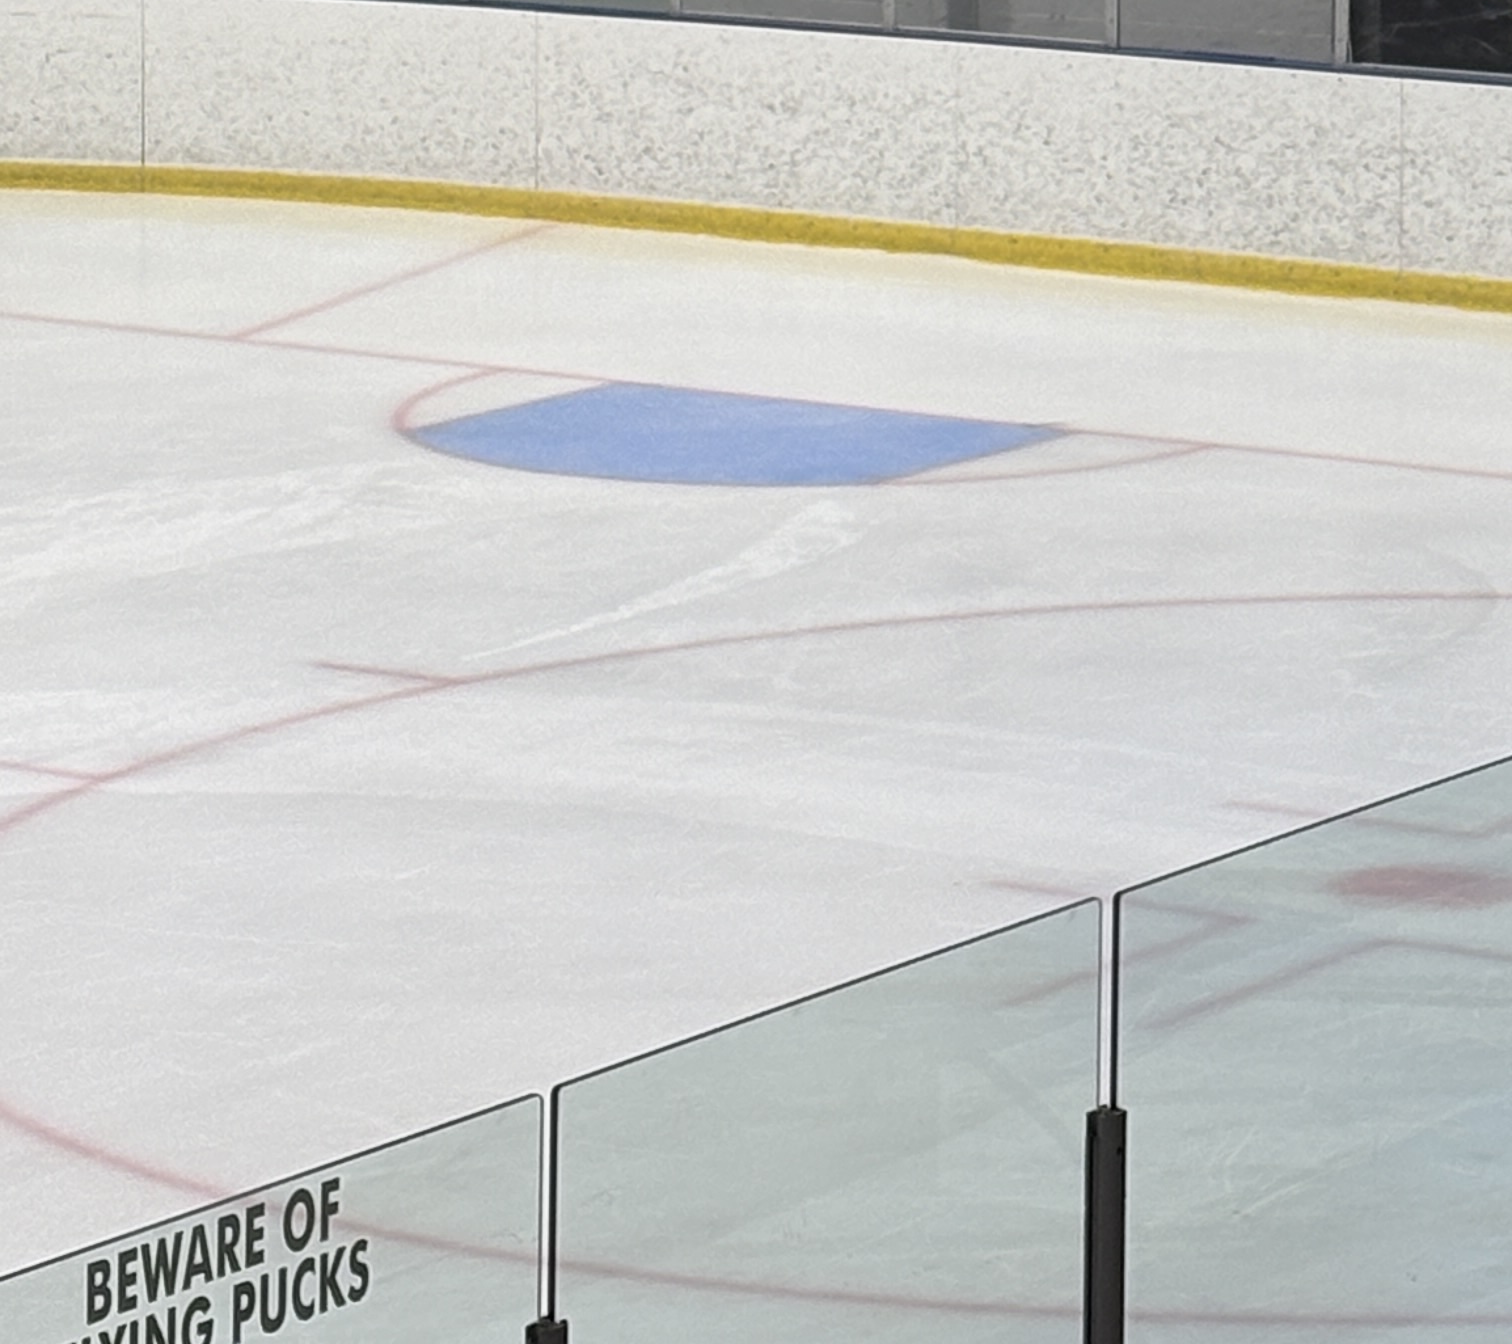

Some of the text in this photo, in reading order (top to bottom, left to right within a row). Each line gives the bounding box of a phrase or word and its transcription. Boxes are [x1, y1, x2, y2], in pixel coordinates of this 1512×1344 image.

[86, 1202, 265, 1325] BEWARE
[283, 1177, 340, 1252] OF
[232, 1238, 369, 1344] PUCKS
